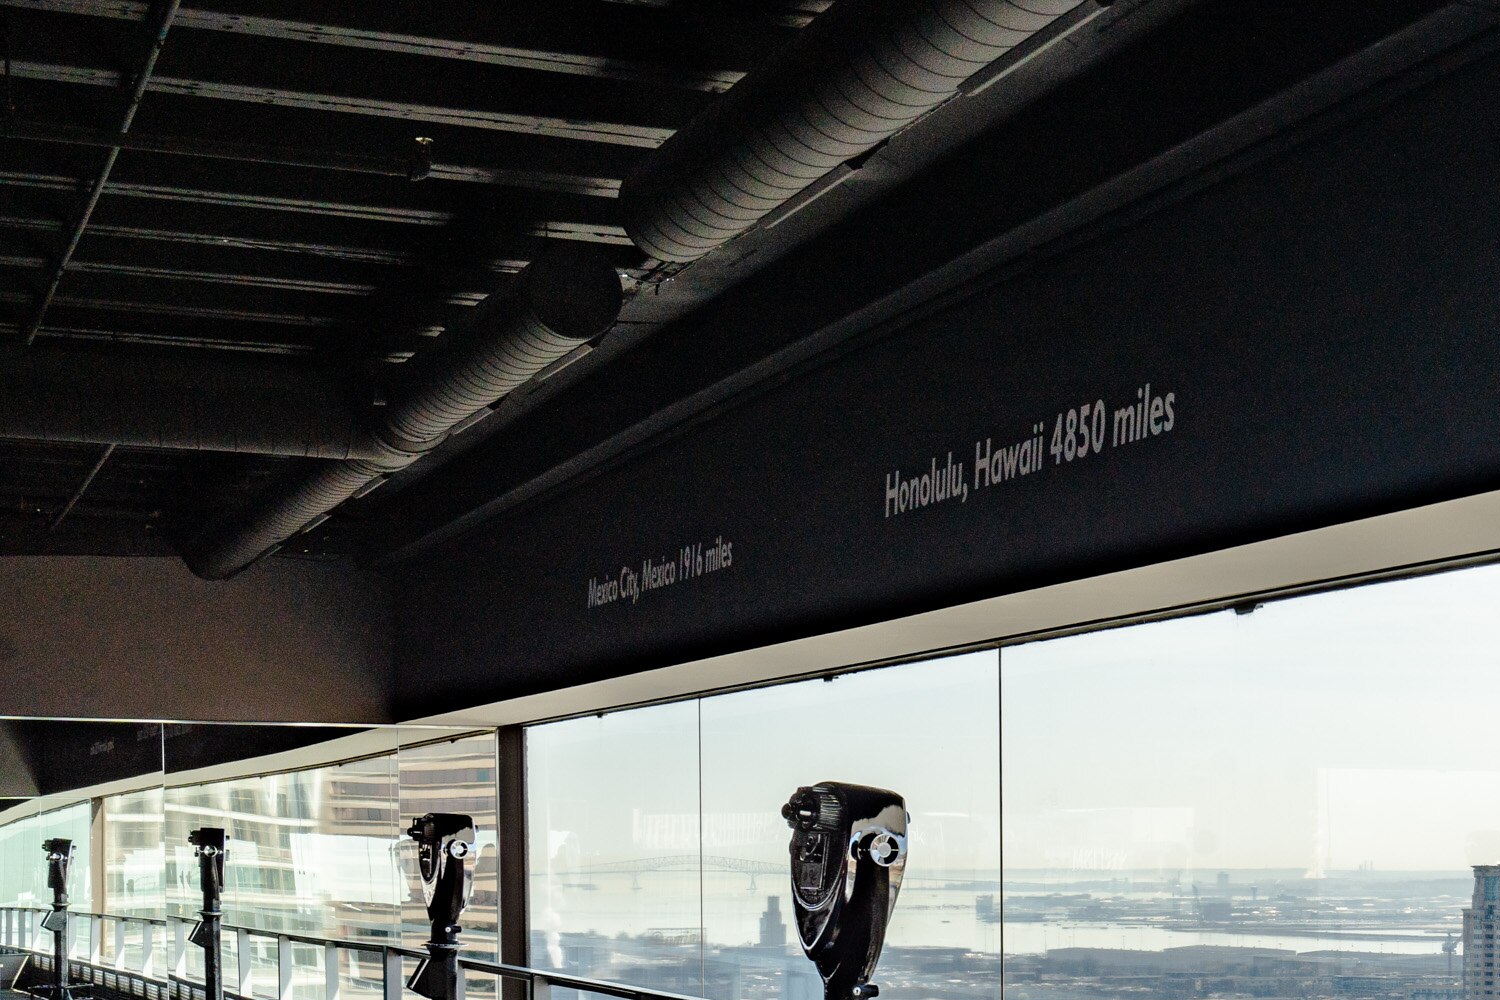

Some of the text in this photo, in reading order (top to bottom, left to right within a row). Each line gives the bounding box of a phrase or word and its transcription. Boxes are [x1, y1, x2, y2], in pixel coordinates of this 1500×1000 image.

[885, 383, 1175, 518] Honolulu, Hawaii 4850 miles
[587, 535, 733, 609] Mexico City, Mexico 1916 miles
